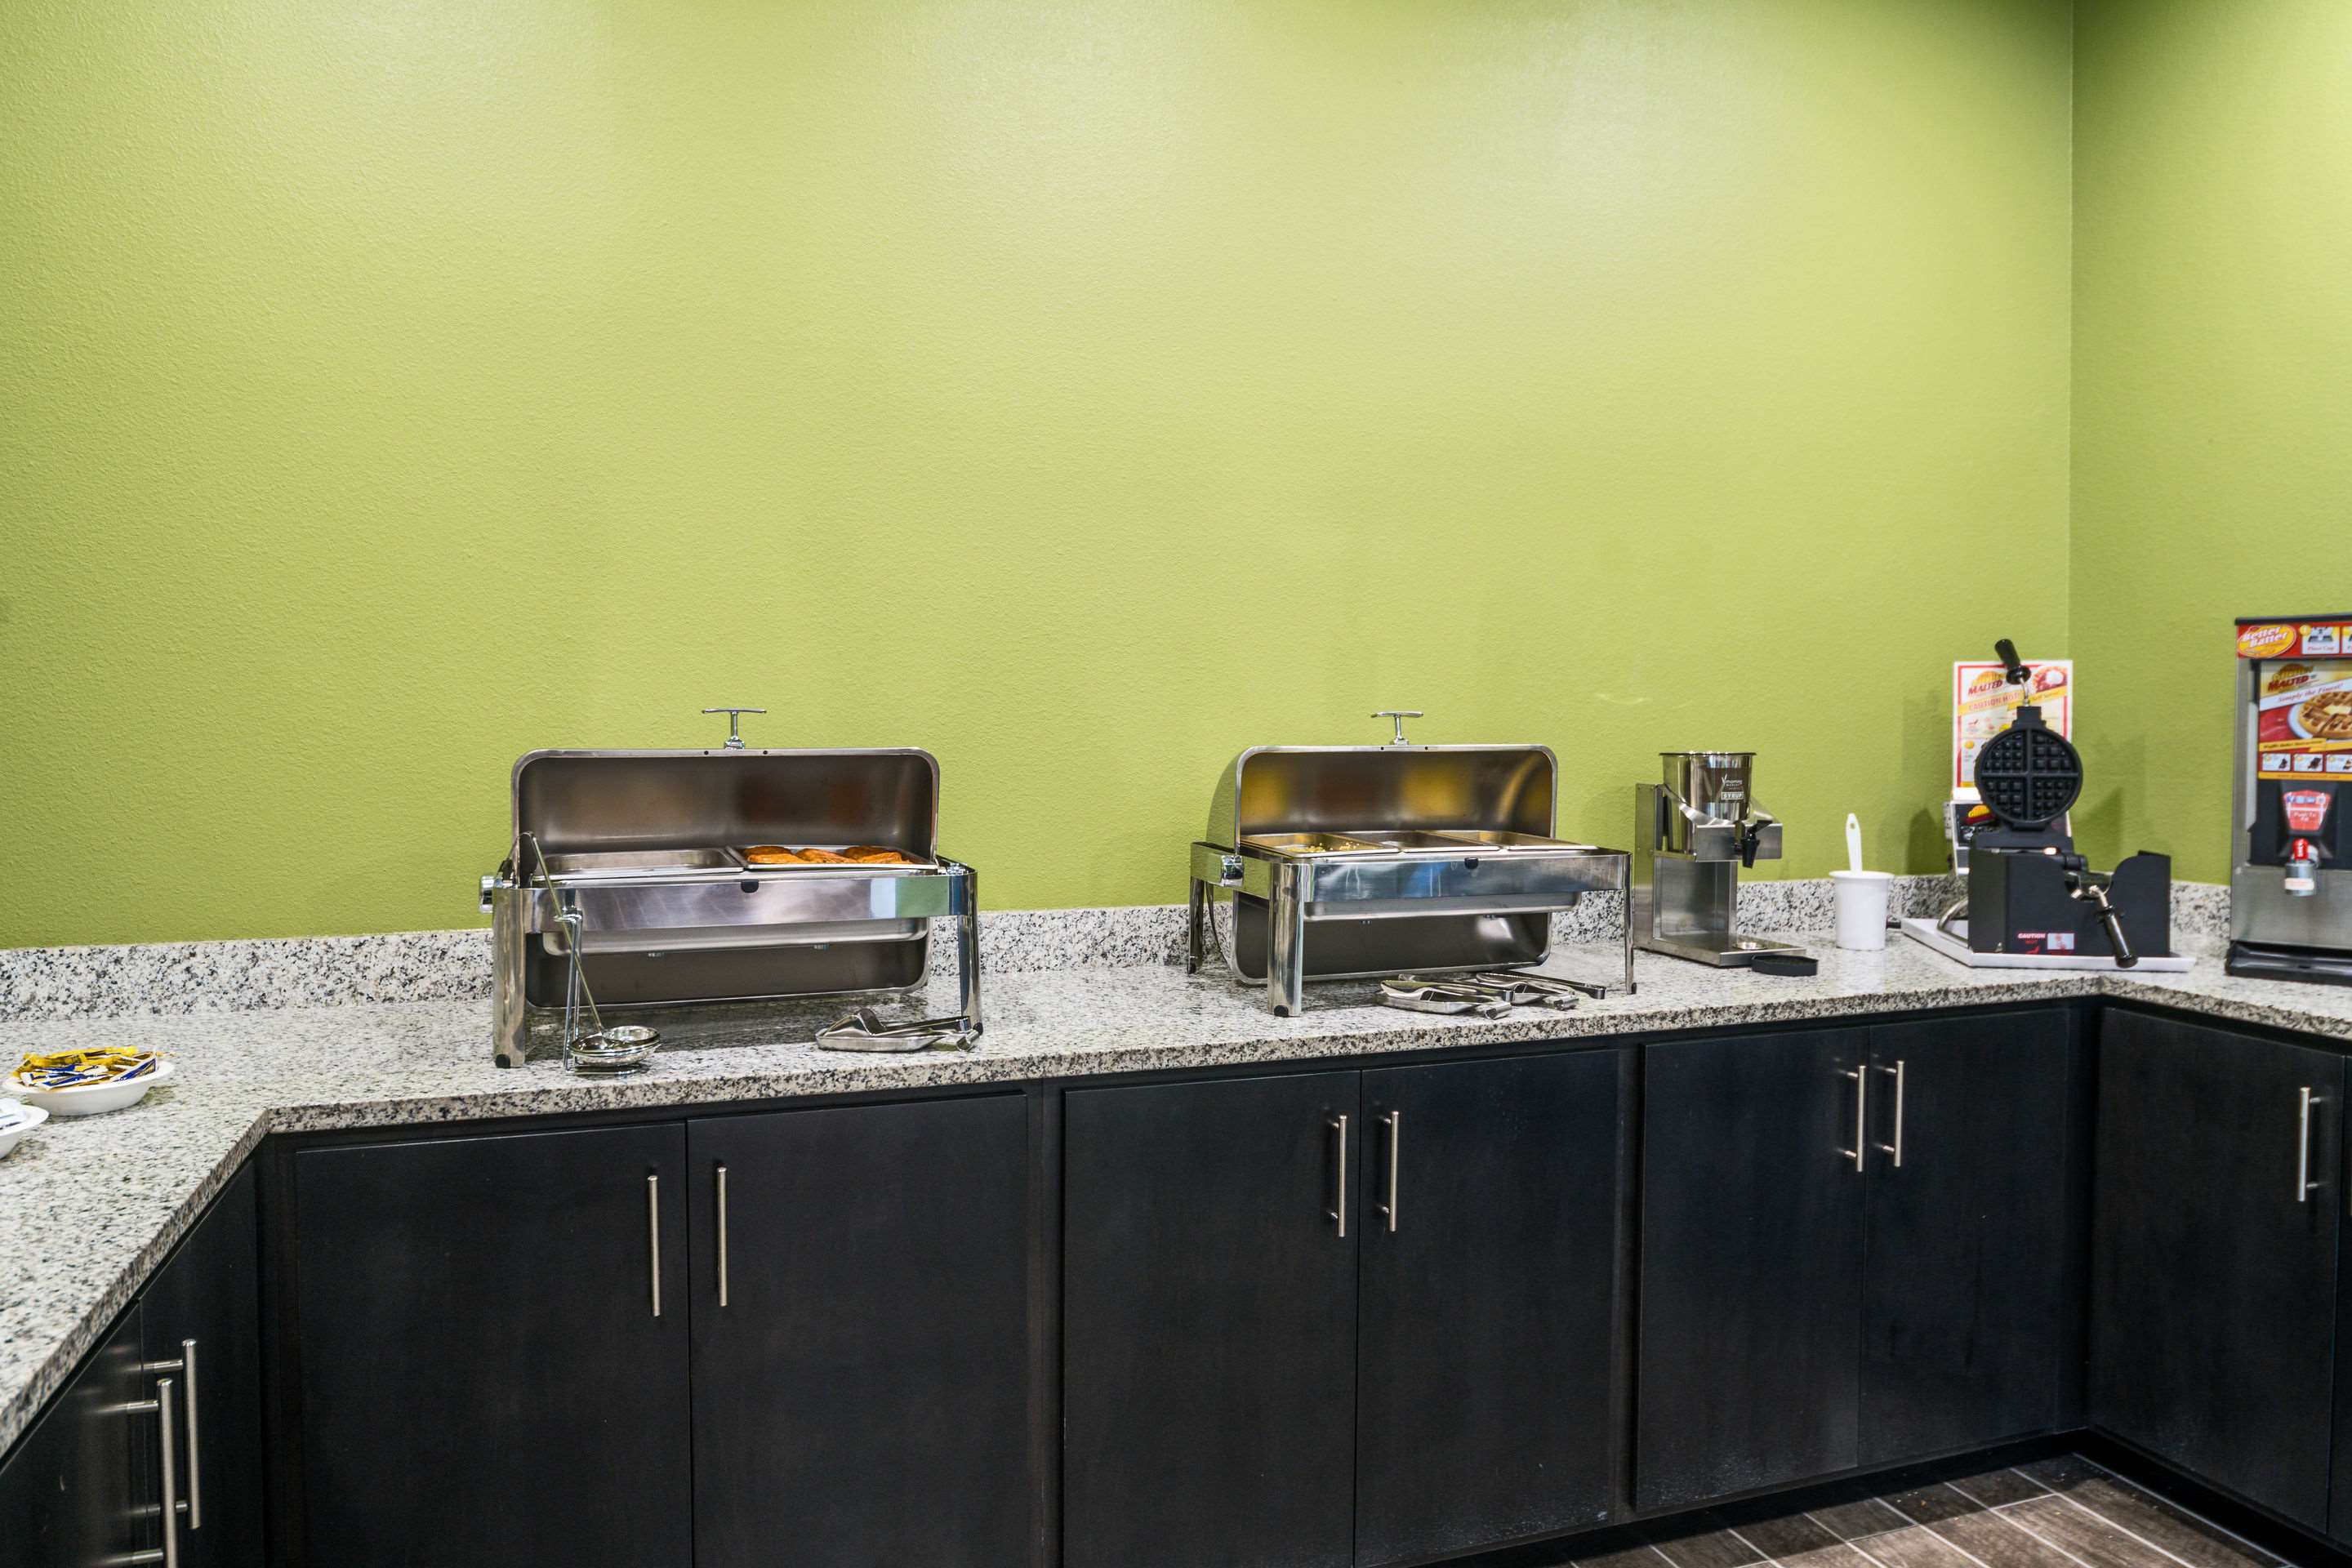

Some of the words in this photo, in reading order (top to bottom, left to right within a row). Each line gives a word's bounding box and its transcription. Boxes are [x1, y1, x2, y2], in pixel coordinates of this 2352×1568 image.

[2241, 626, 2281, 642] Better
[2249, 632, 2288, 648] Batter
[1968, 679, 2003, 695] MALTED
[2268, 675, 2310, 692] MALTED
[1968, 697, 2002, 710] CAUTION
